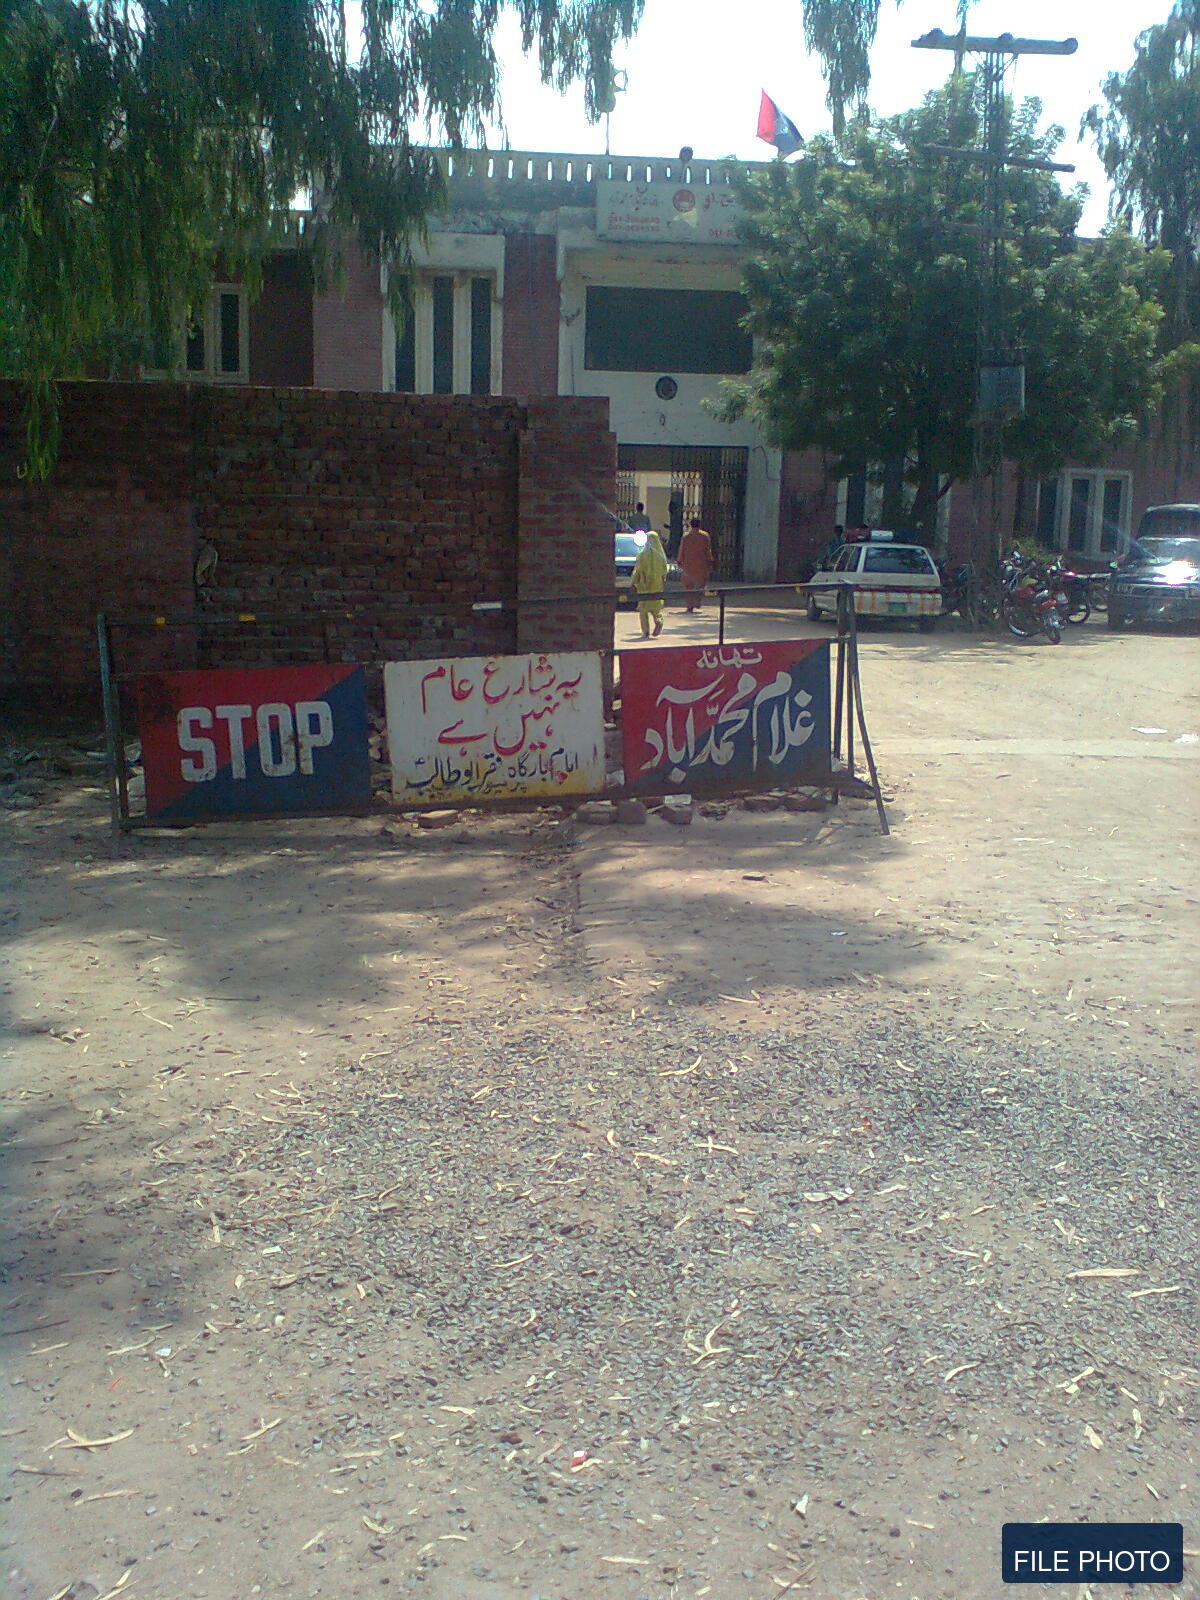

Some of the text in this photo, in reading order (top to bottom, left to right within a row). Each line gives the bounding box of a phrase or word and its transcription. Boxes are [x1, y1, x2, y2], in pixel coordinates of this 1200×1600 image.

[421, 656, 583, 714] یہ شارع عام
[177, 701, 334, 782] STOP
[437, 694, 560, 757] نہیں ہے
[753, 671, 816, 772] غلام
[550, 746, 578, 781] امام
